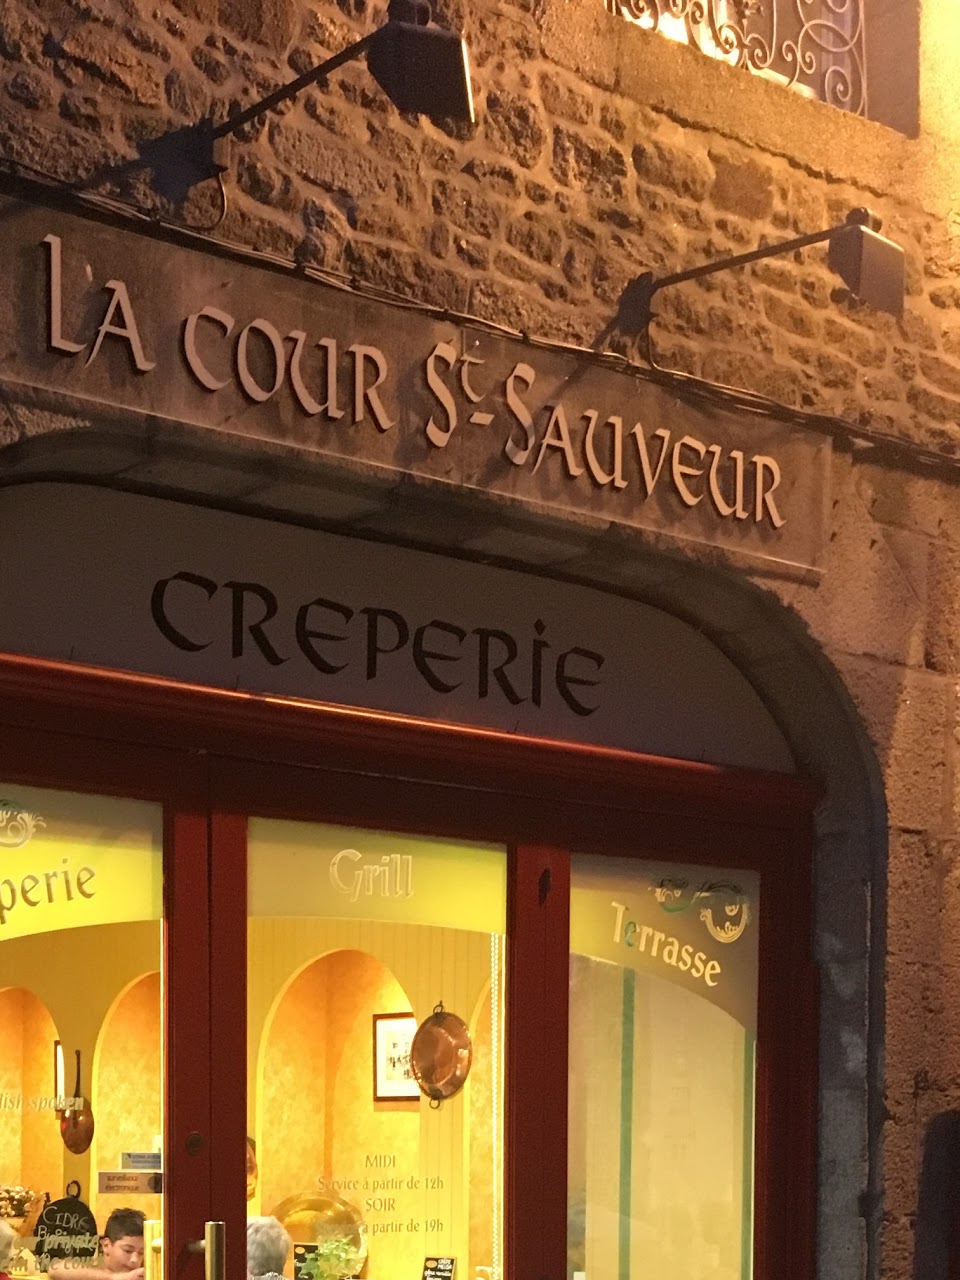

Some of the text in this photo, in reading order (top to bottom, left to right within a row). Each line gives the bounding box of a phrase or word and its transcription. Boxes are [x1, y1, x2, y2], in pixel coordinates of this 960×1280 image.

[184, 305, 397, 433] COUR
[329, 848, 415, 903] Grill
[611, 900, 722, 988] Terrasse
[27, 1094, 85, 1112] spoken
[364, 1154, 396, 1168] MIDI
[318, 1176, 360, 1190] Service
[372, 1177, 403, 1193] partir
[406, 1175, 420, 1190] de
[424, 1175, 444, 1190] 12h
[365, 1197, 396, 1212] SOIR
[372, 1220, 403, 1236] partir
[406, 1218, 420, 1233] de
[424, 1218, 444, 1233] 19h
